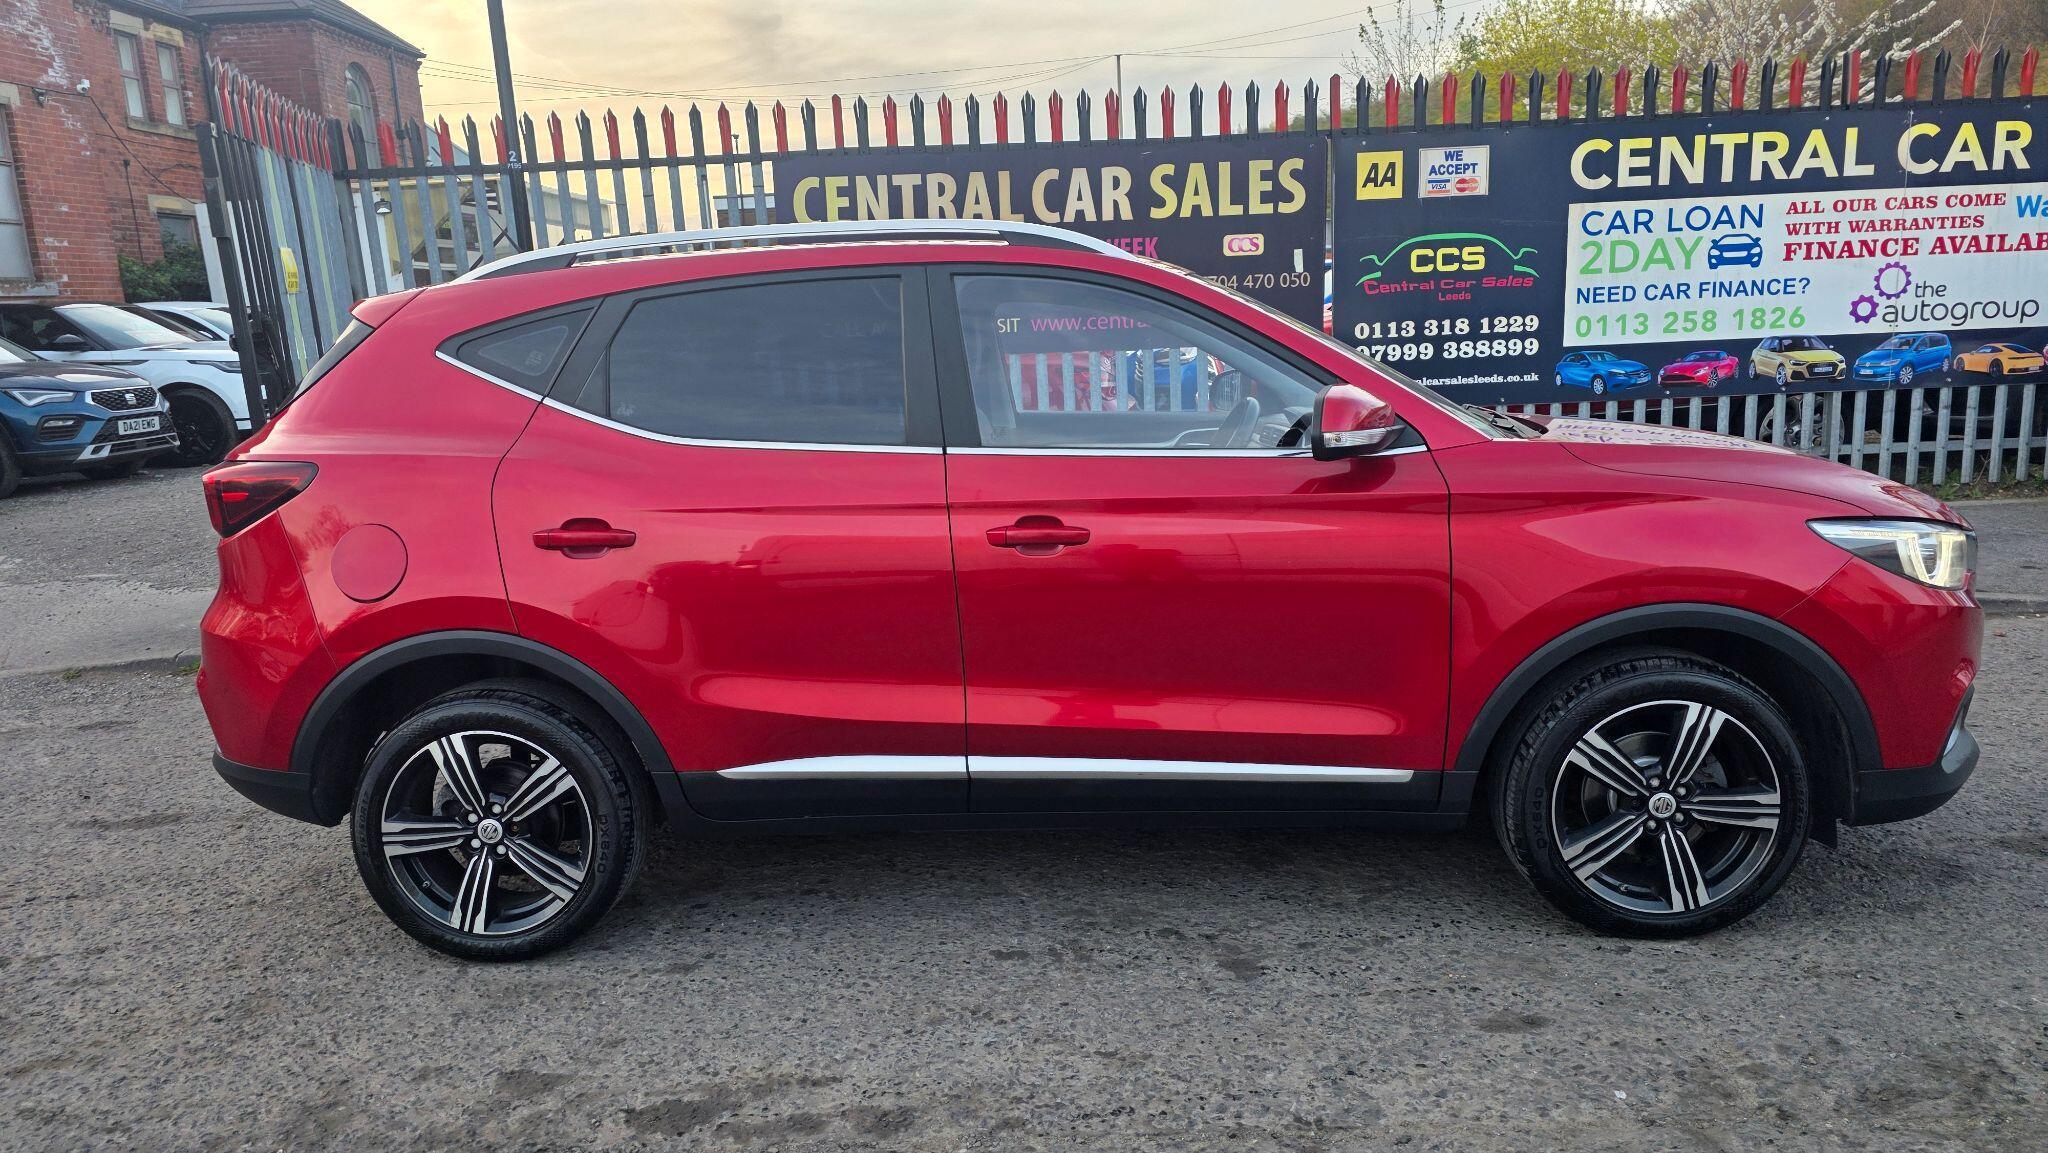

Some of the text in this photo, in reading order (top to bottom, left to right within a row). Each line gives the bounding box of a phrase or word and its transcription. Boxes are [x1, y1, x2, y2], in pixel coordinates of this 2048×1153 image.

[508, 150, 517, 161] 2
[1444, 150, 1464, 161] WE
[1570, 120, 2033, 190] CENTRAL CAR
[1362, 161, 1396, 188] AA
[1428, 163, 1479, 176] ACCEPT
[793, 158, 1306, 223] CENTRAL CAR SALES
[1786, 193, 2007, 215] ALL OUR CARS COME
[1581, 203, 1764, 236] CAR LOAN
[1785, 215, 1985, 236] WITH WARRANTIES
[1410, 246, 1486, 273] CCS
[1579, 236, 1704, 275] 2DAY
[1782, 237, 1920, 262] FINANCE
[1243, 274, 1275, 289] 470
[1280, 272, 1311, 288] 050
[1363, 275, 1534, 295] Central Car Sales
[1576, 277, 1811, 304] NEED CAR FINANCE?
[1914, 281, 1947, 298] the
[1438, 292, 1472, 301] Leeds
[1575, 306, 1807, 338] 0113 258 1826
[1881, 299, 2040, 327] autogroup
[1354, 314, 1540, 339] 0113 318 1229
[1443, 337, 1540, 359] 388899
